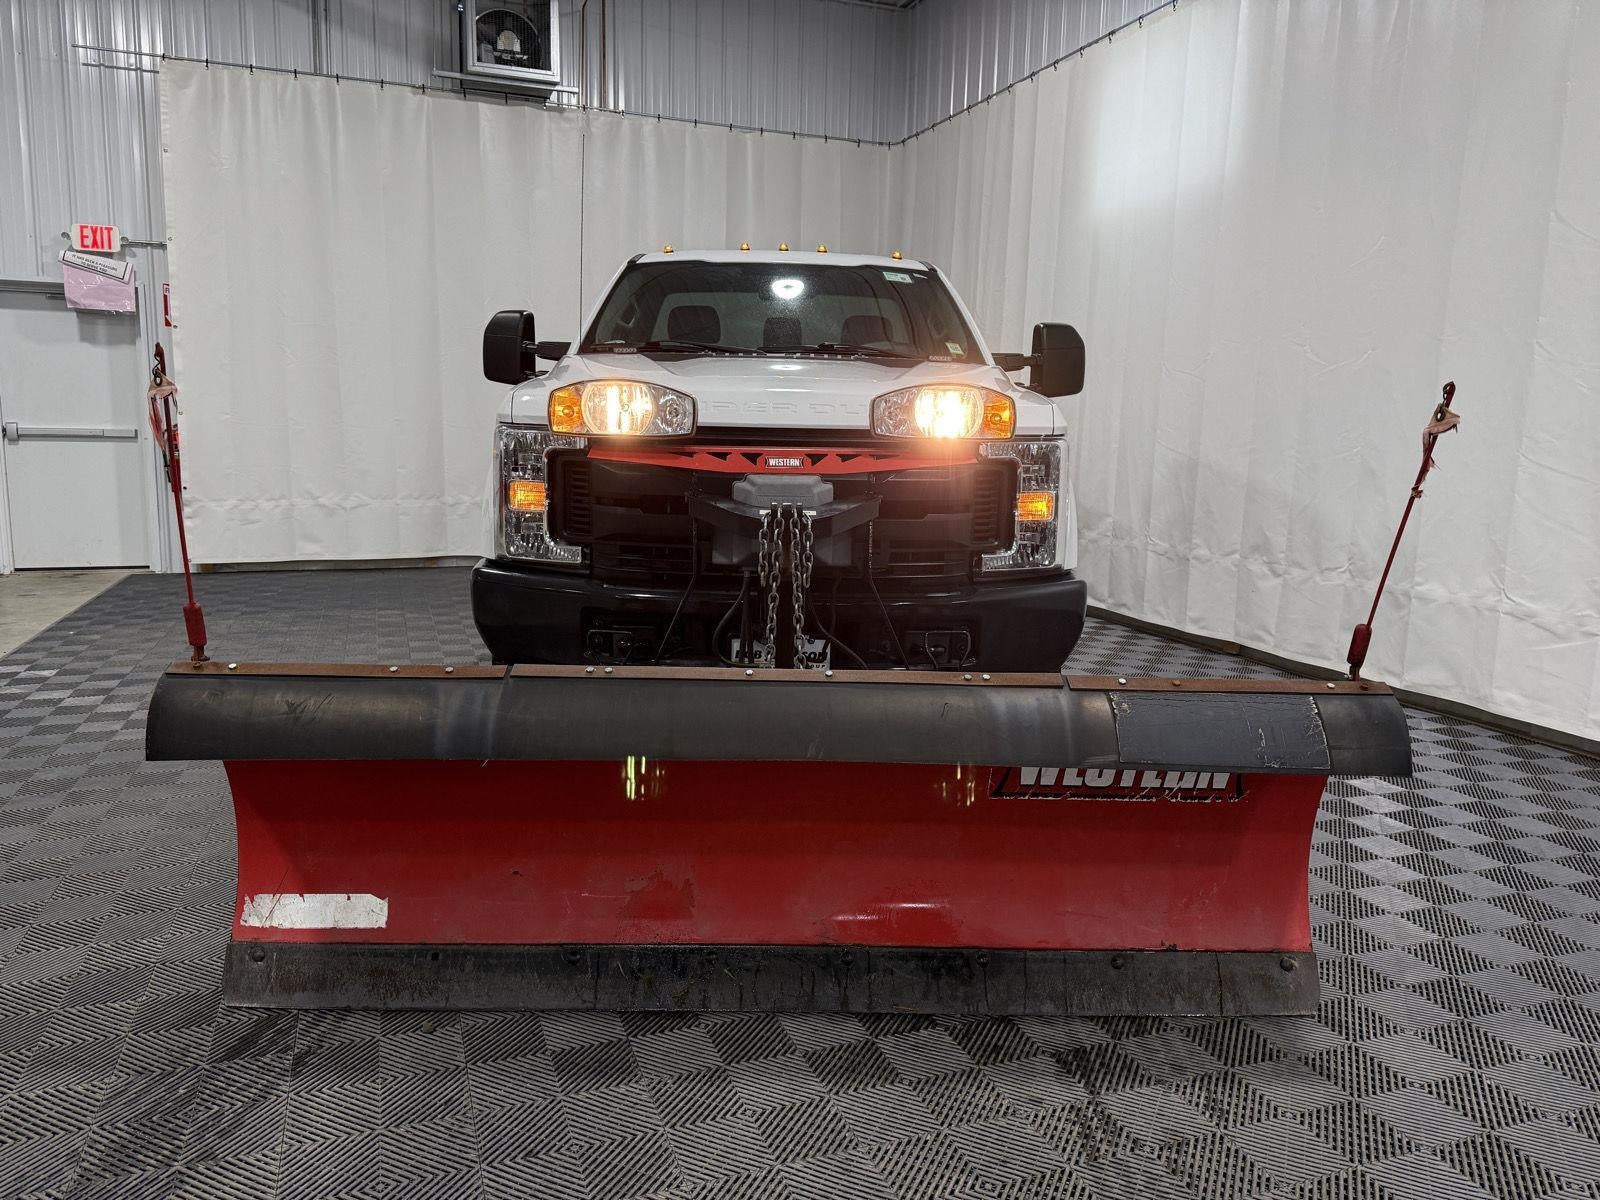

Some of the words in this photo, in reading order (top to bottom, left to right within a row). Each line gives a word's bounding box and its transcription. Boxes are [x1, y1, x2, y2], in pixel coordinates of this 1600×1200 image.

[80, 225, 113, 250] EXIT
[700, 401, 799, 415] PER
[808, 403, 867, 415] DU
[768, 458, 800, 467] WESTERN
